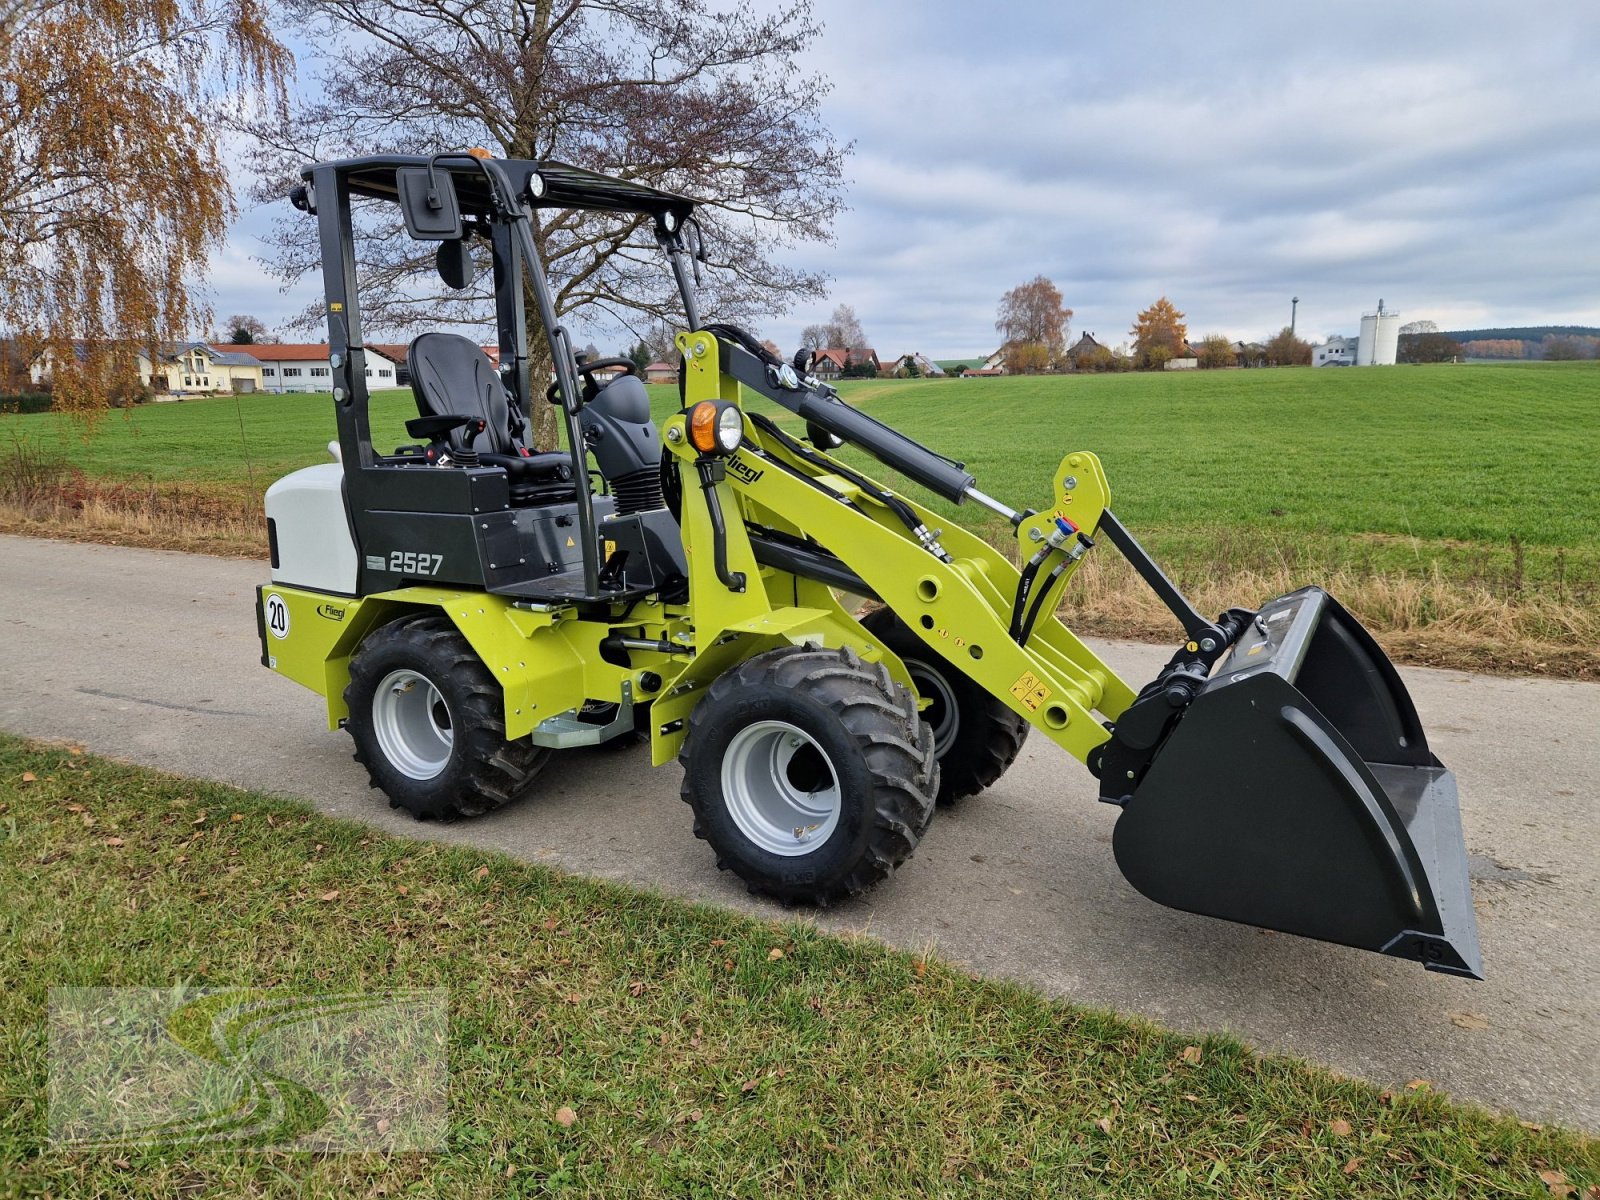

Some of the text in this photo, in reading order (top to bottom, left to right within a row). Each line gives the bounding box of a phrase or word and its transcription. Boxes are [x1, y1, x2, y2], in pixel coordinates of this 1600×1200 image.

[389, 550, 444, 576] 2527
[269, 600, 285, 631] 20
[324, 604, 346, 620] Fliegl
